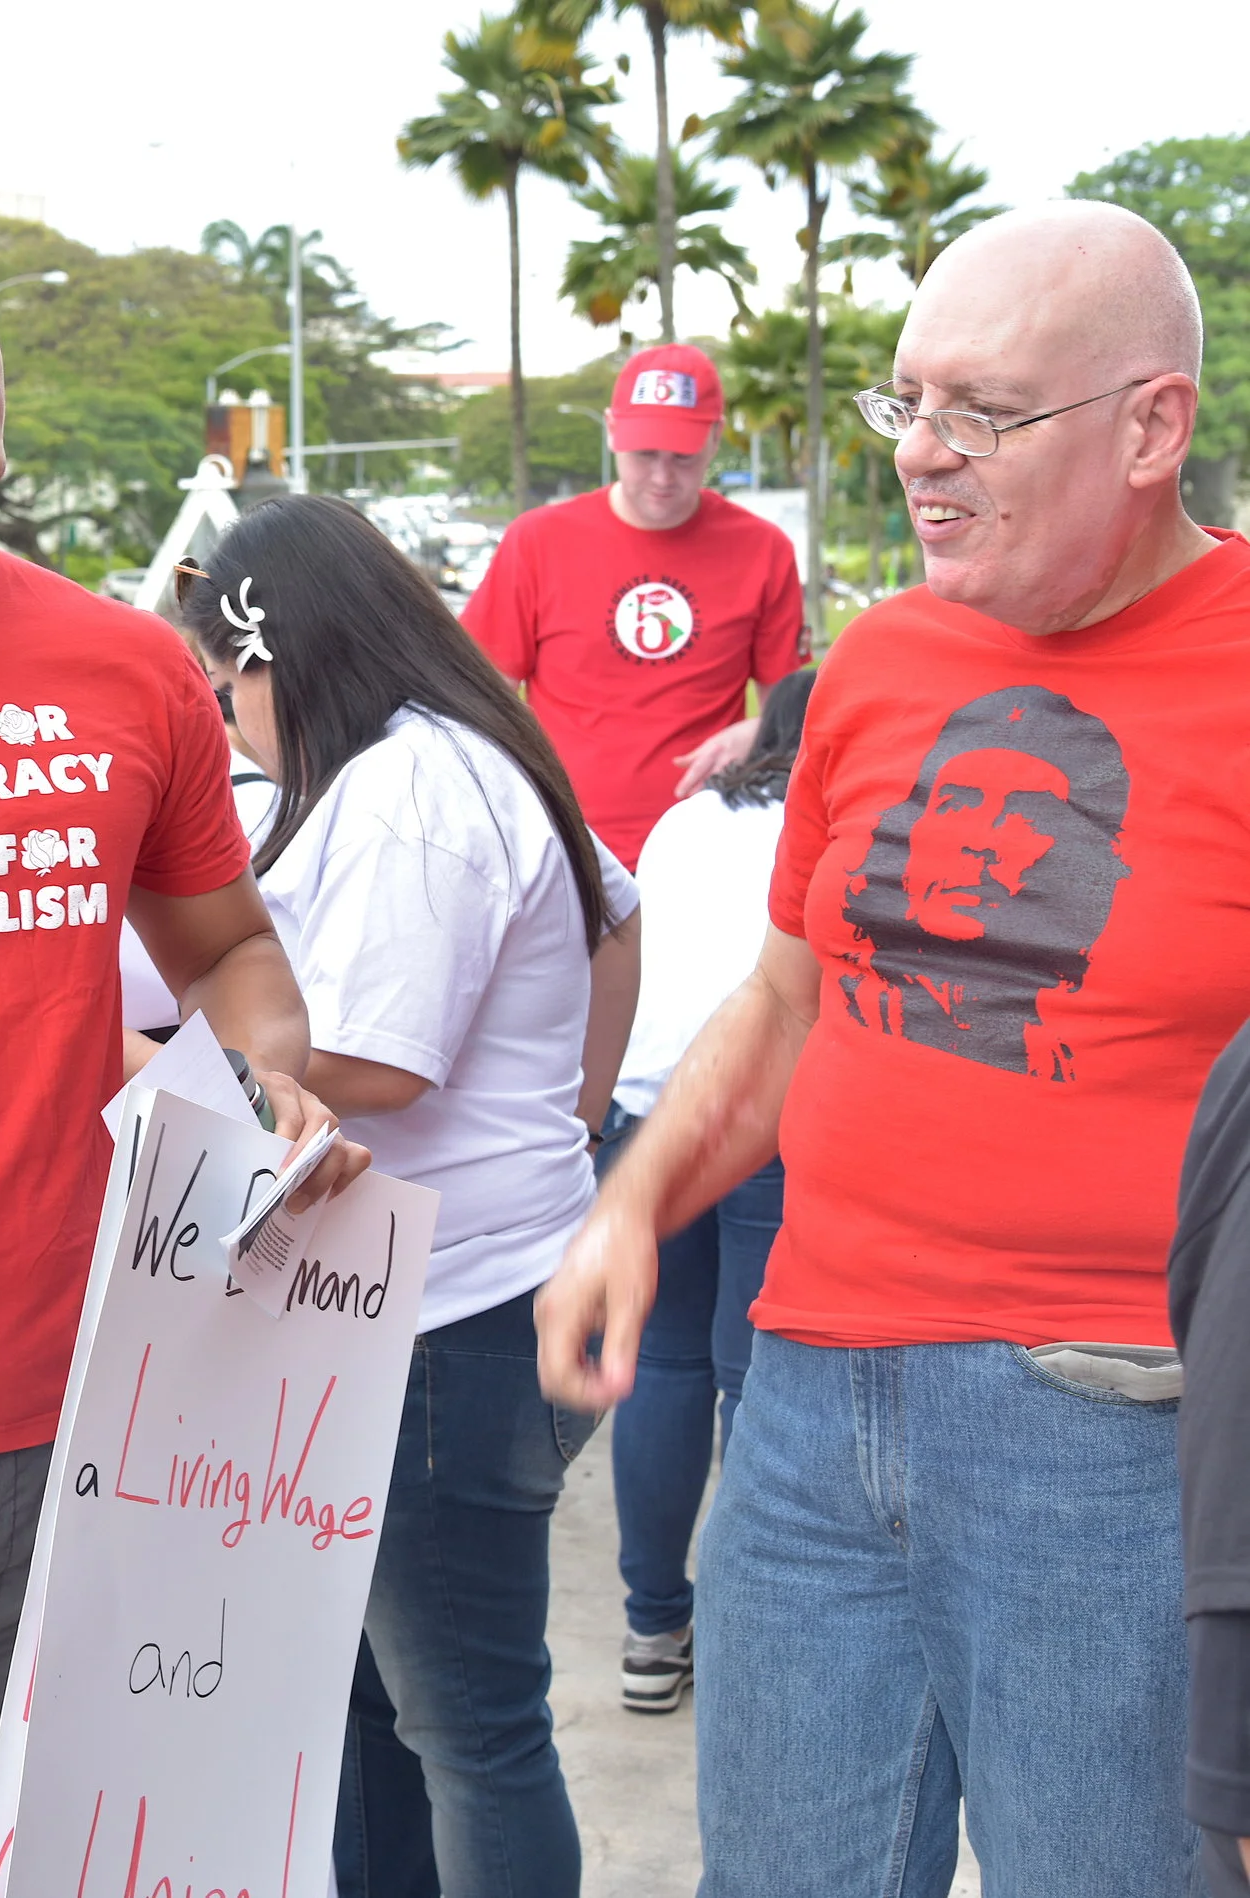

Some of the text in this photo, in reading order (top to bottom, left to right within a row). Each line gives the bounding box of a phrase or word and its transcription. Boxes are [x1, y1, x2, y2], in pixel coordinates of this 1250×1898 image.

[132, 1122, 208, 1282] We
[75, 1342, 375, 1552] a Living Wage
[128, 1597, 227, 1699] and
